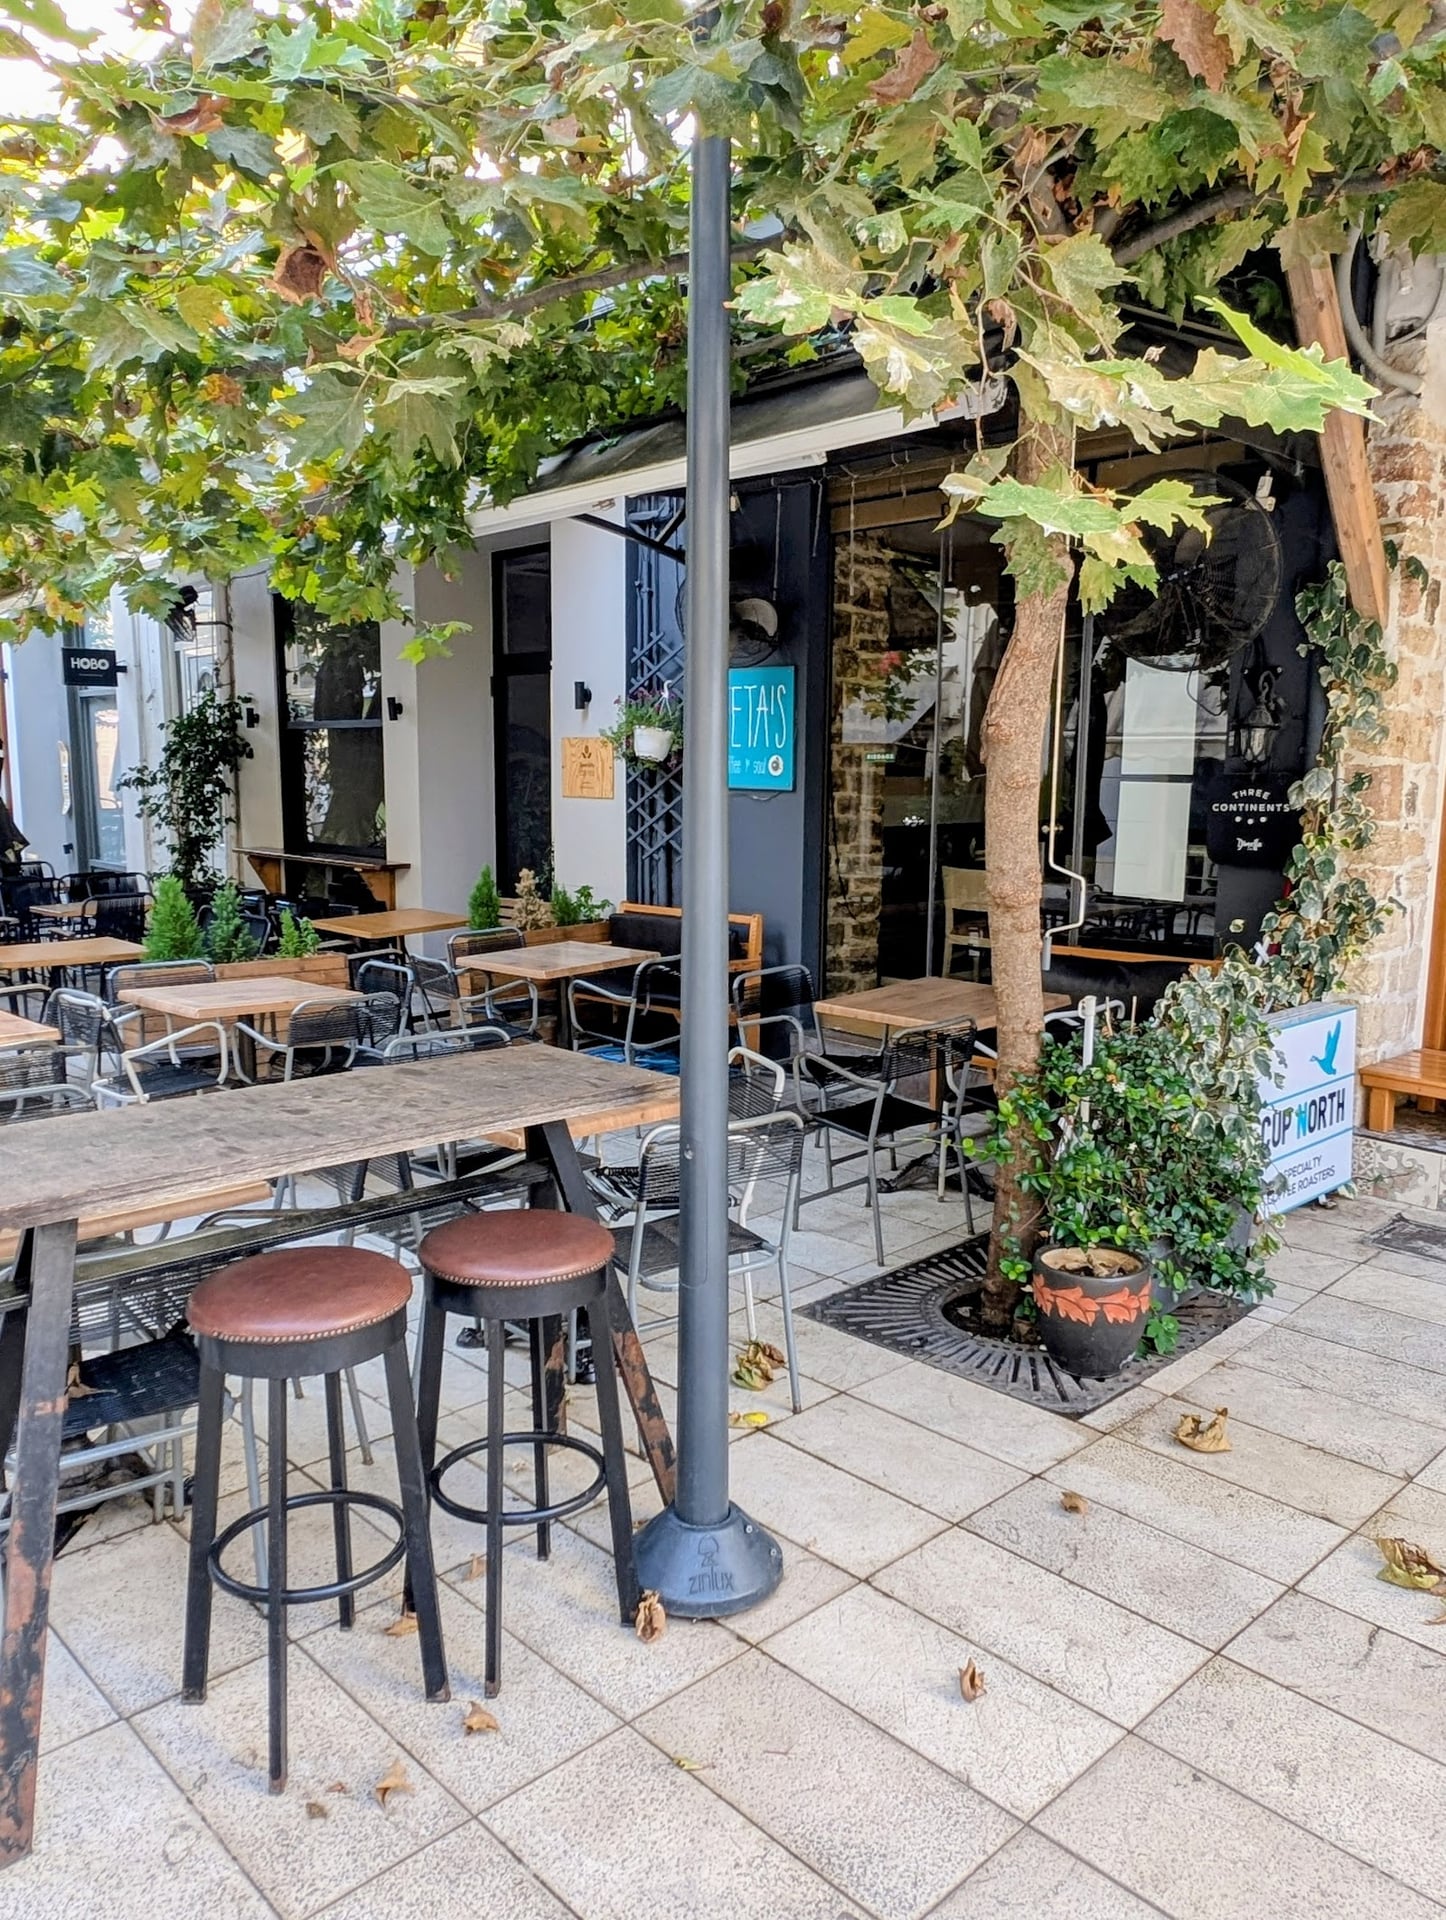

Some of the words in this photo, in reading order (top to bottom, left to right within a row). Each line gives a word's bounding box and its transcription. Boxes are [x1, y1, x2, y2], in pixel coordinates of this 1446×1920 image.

[70, 657, 110, 670] HOBO
[730, 684, 787, 749] ETA'S
[1231, 788, 1272, 800] THREE
[1211, 803, 1290, 812] CONTINENTS
[1261, 1108, 1292, 1148] CUP
[1297, 1087, 1346, 1139] NORTH
[1297, 1165, 1335, 1191] ROASTERS
